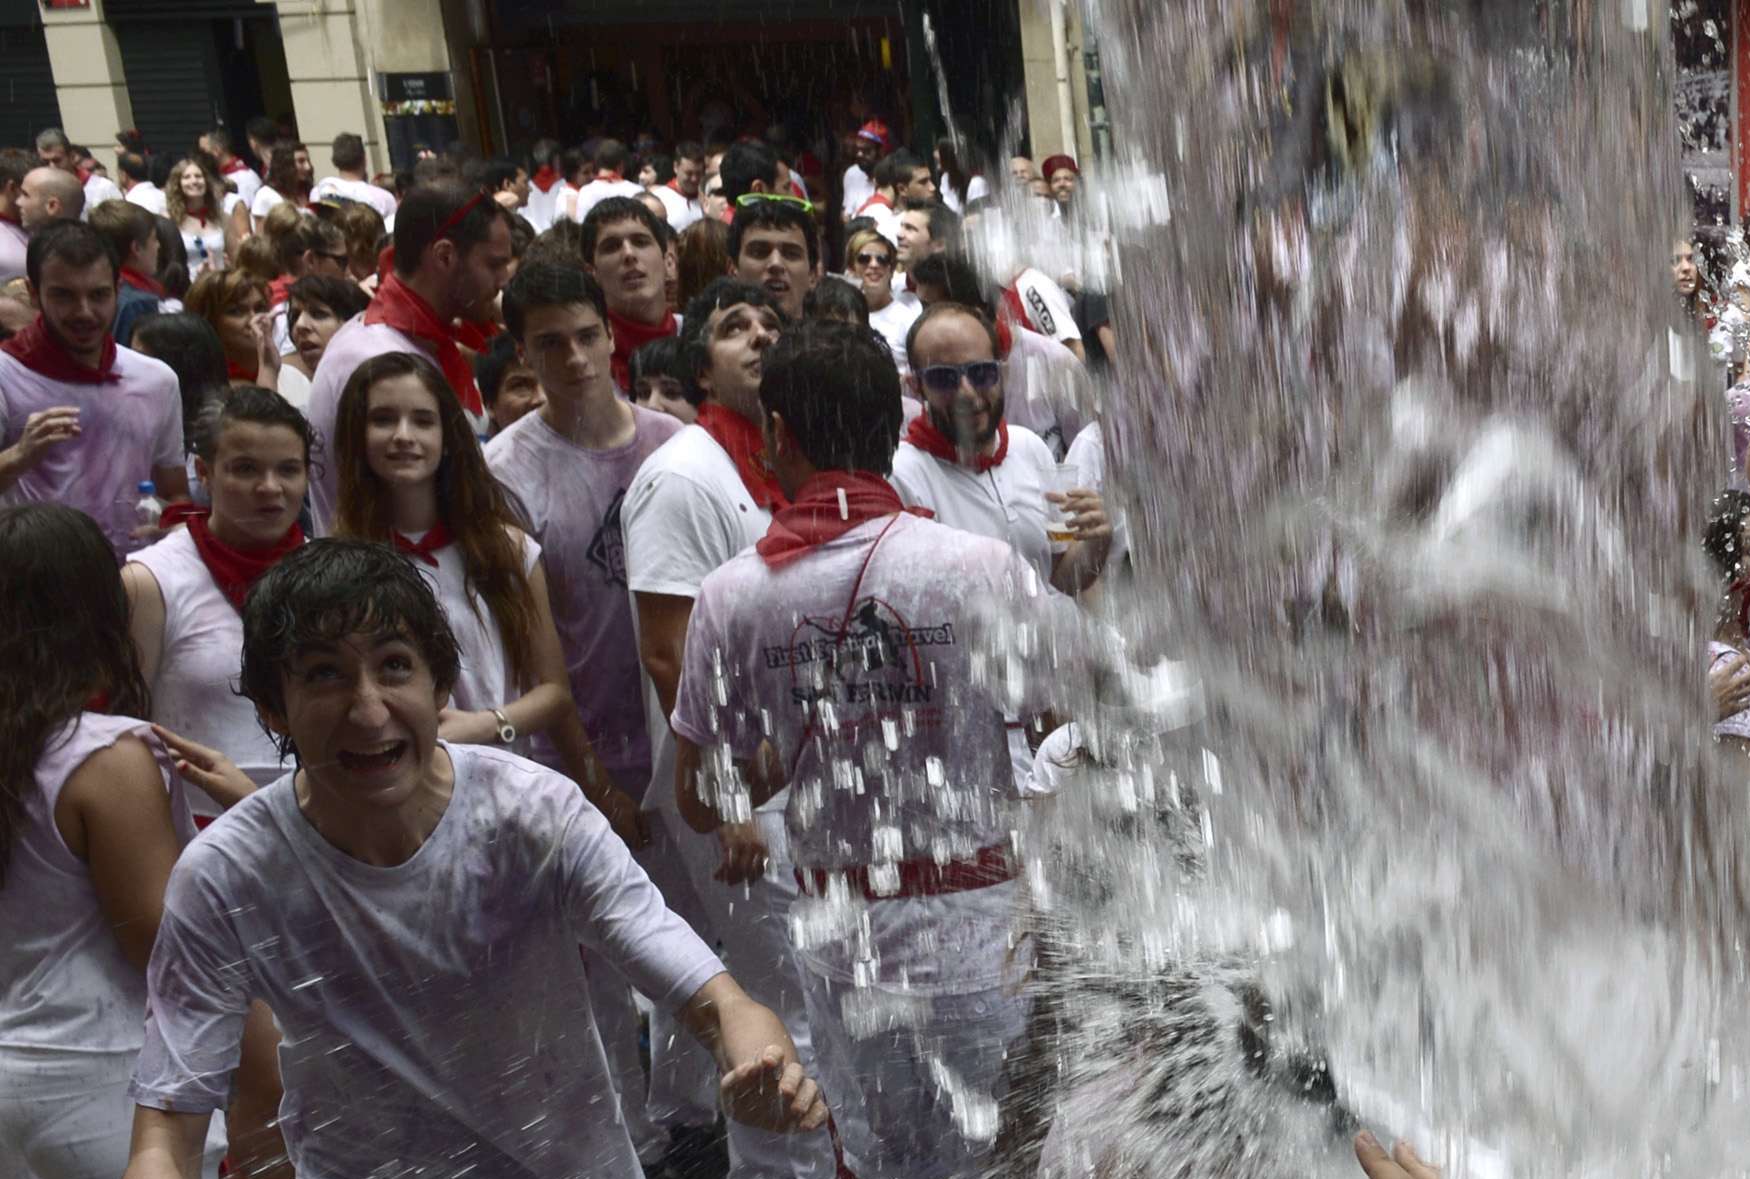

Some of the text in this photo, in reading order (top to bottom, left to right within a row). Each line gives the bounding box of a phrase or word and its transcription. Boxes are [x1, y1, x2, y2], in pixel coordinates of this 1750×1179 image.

[763, 643, 812, 668] First
[889, 624, 955, 646] Travel
[847, 684, 932, 703] FERMIN
